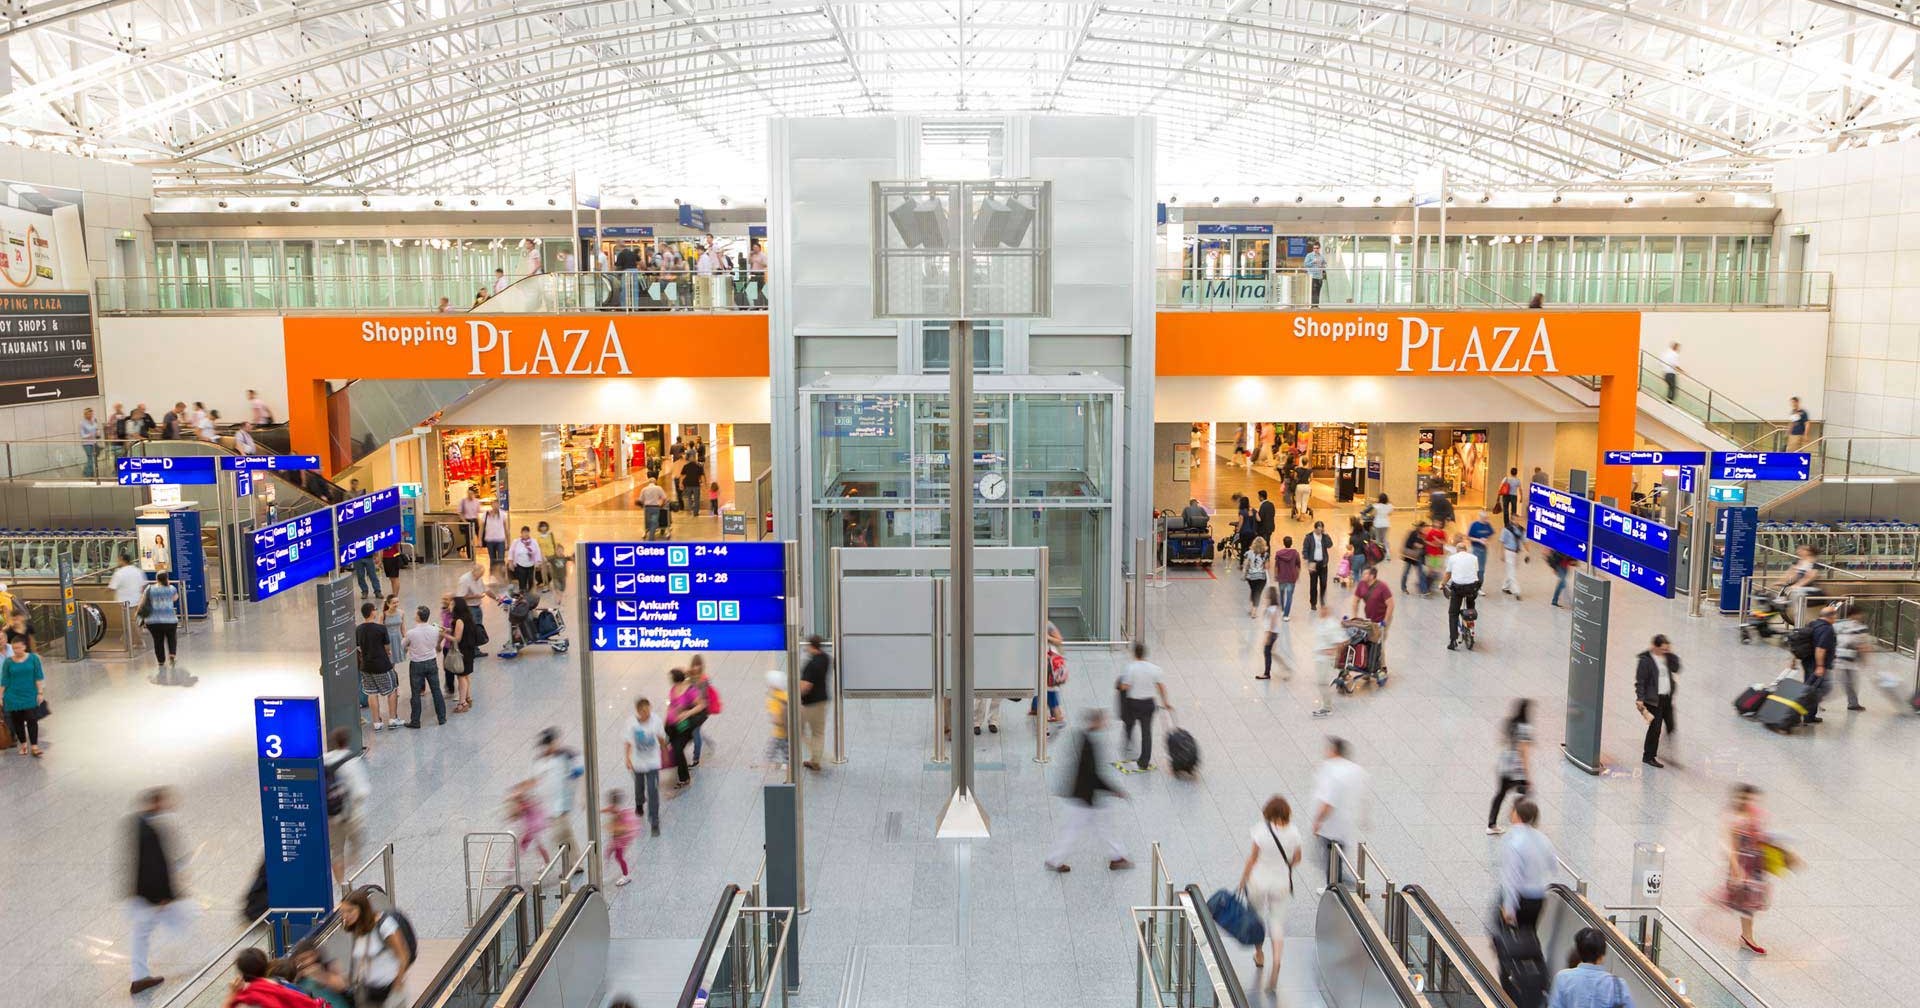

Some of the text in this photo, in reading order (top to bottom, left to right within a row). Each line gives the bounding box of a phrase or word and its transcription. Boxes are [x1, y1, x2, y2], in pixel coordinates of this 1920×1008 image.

[33, 297, 62, 310] PLAZA
[18, 319, 47, 332] SHOPS
[52, 320, 58, 331] &
[0, 340, 48, 354] TAURANTS
[55, 340, 66, 351] IN
[361, 320, 632, 375] Shopping PLAZA
[1293, 317, 1558, 373] Shopping PLAZA
[268, 457, 276, 468] E
[1653, 452, 1663, 463] D
[1759, 454, 1767, 464] E
[163, 458, 173, 469] D
[636, 546, 665, 556] Gates
[637, 573, 666, 583] Gates
[639, 600, 679, 611] Ankunft
[639, 611, 677, 621] Arrivals
[639, 627, 692, 638] Treffpunkt
[640, 638, 709, 650] Meeting Point
[266, 735, 282, 758] 3
